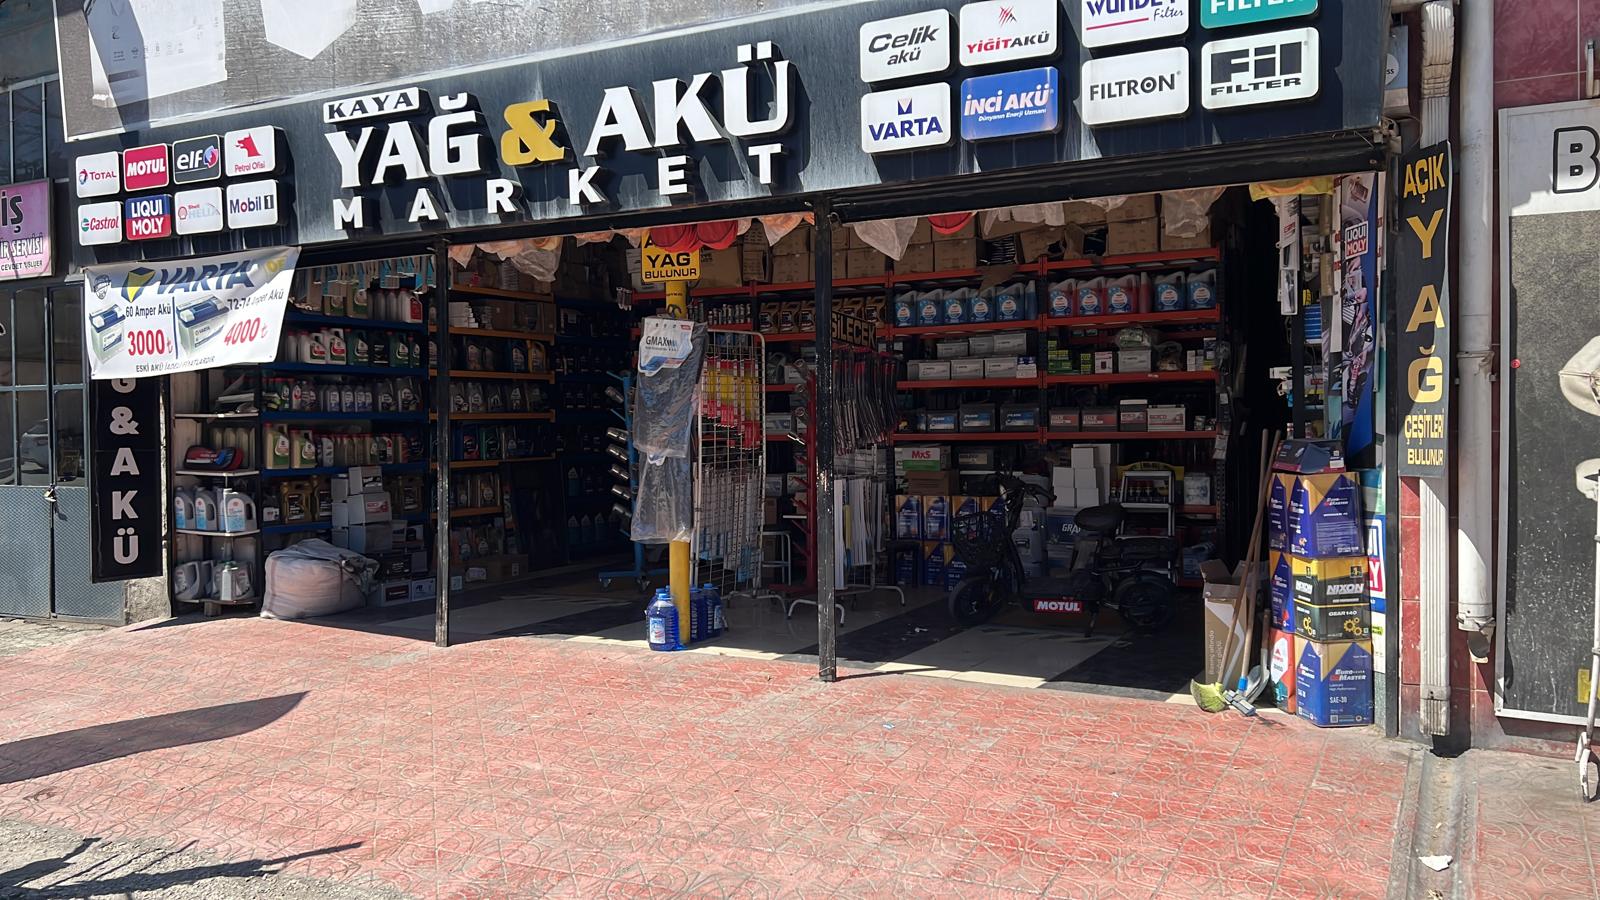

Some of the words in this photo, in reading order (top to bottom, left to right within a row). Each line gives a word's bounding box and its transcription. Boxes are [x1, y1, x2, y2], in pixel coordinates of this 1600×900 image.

[1153, 7, 1184, 22] Filter
[886, 49, 920, 65] akü
[1090, 73, 1176, 101] FILTRON
[1211, 77, 1302, 96] FILTER
[329, 92, 415, 120] KAYA
[964, 90, 1003, 116] İNCİ
[1005, 83, 1050, 110] AKÜ
[325, 92, 482, 188] YAĞ
[501, 99, 565, 166] &
[584, 40, 790, 156] AKÜ
[868, 116, 943, 141] VARTA
[127, 161, 166, 177] MOTUL
[176, 150, 203, 170] elf
[234, 164, 250, 173] Petrol
[89, 170, 117, 181] TOTAL
[1403, 152, 1446, 203] AÇIK
[333, 143, 782, 230] MARKET
[131, 200, 163, 218] LIQUI
[230, 198, 262, 214] Mobil
[265, 195, 274, 210] 1
[89, 215, 119, 231] Castrol
[132, 218, 164, 235] MOLY
[1346, 224, 1367, 243] LIQUI
[1347, 239, 1367, 257] MOLY
[156, 260, 254, 294] VARTA
[644, 268, 697, 279] BULUNUR
[126, 306, 134, 318] 60
[135, 304, 156, 319] Amper
[157, 302, 172, 316] Akü
[136, 363, 149, 372] ESKİ
[109, 406, 139, 435] &
[1404, 409, 1444, 446] ÇEŞİTLERİ
[1407, 448, 1443, 467] BULUNUR
[1061, 523, 1081, 535] GRA
[1326, 583, 1364, 596] NIXON
[1037, 601, 1080, 611] MOTUL
